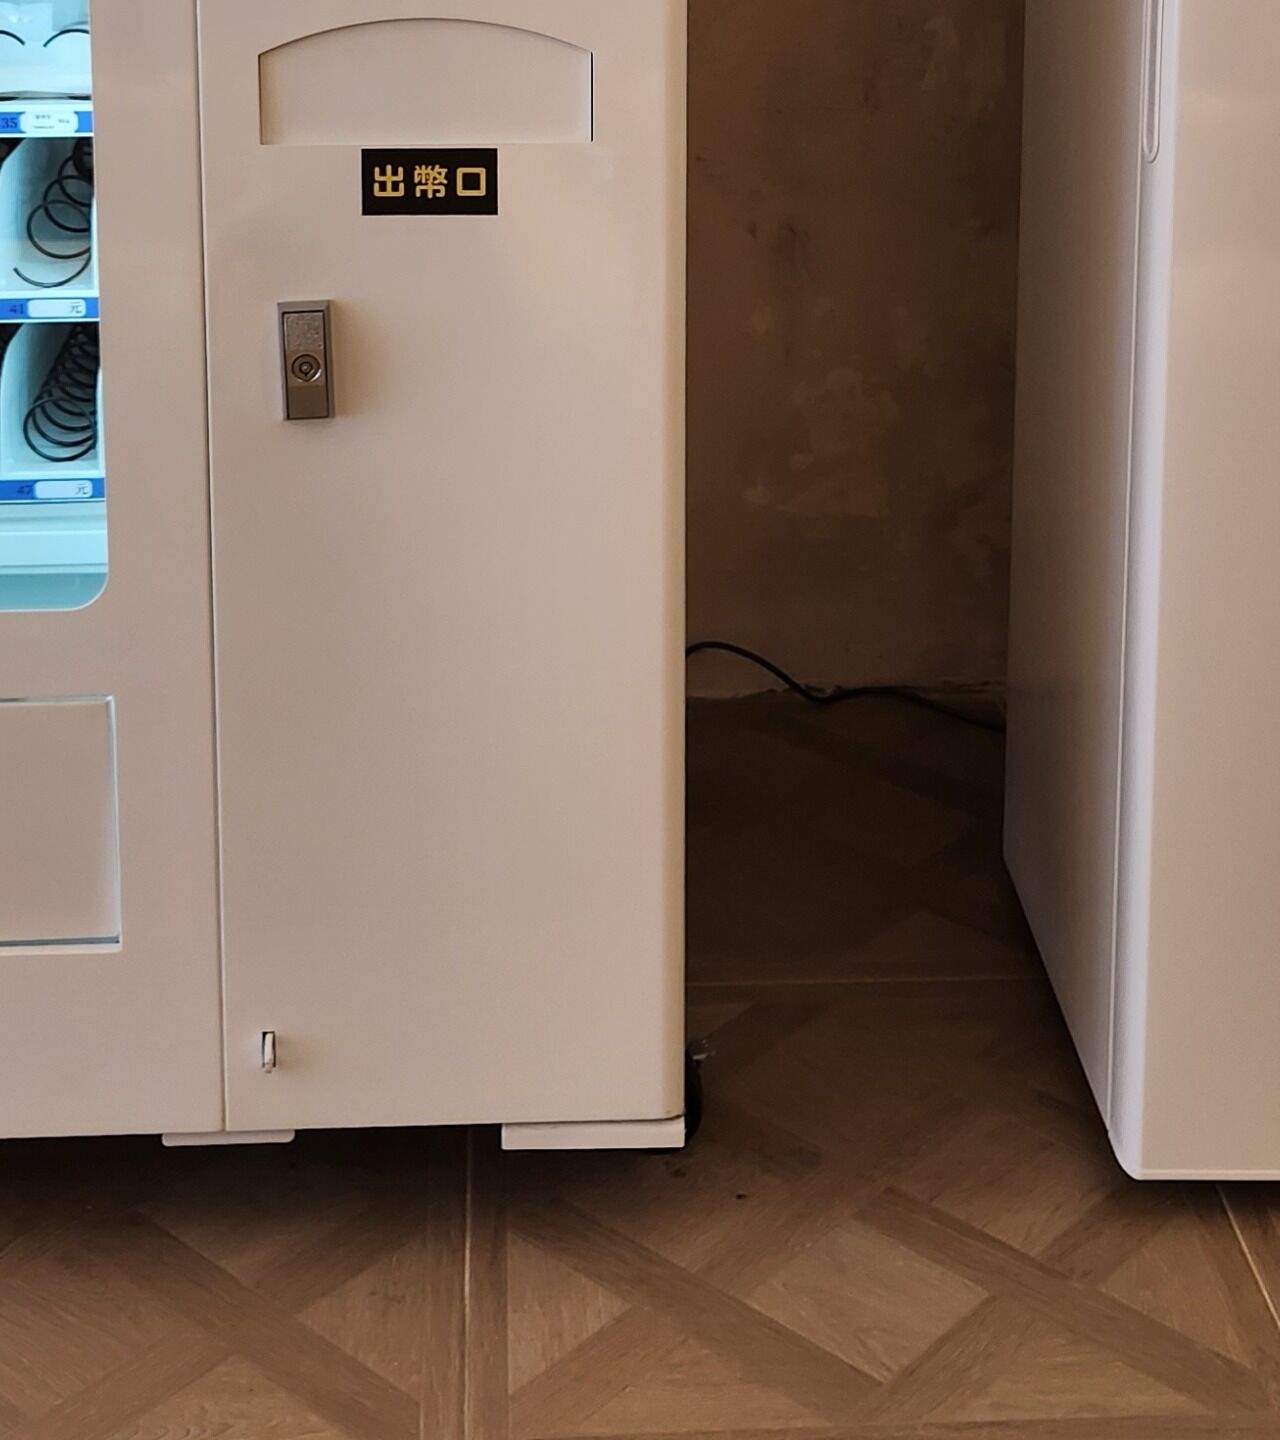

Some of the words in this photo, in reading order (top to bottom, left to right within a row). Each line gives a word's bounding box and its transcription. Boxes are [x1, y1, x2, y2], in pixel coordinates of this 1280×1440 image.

[373, 163, 487, 200] 出幣口
[70, 302, 83, 314] 元
[75, 483, 89, 495] 元
